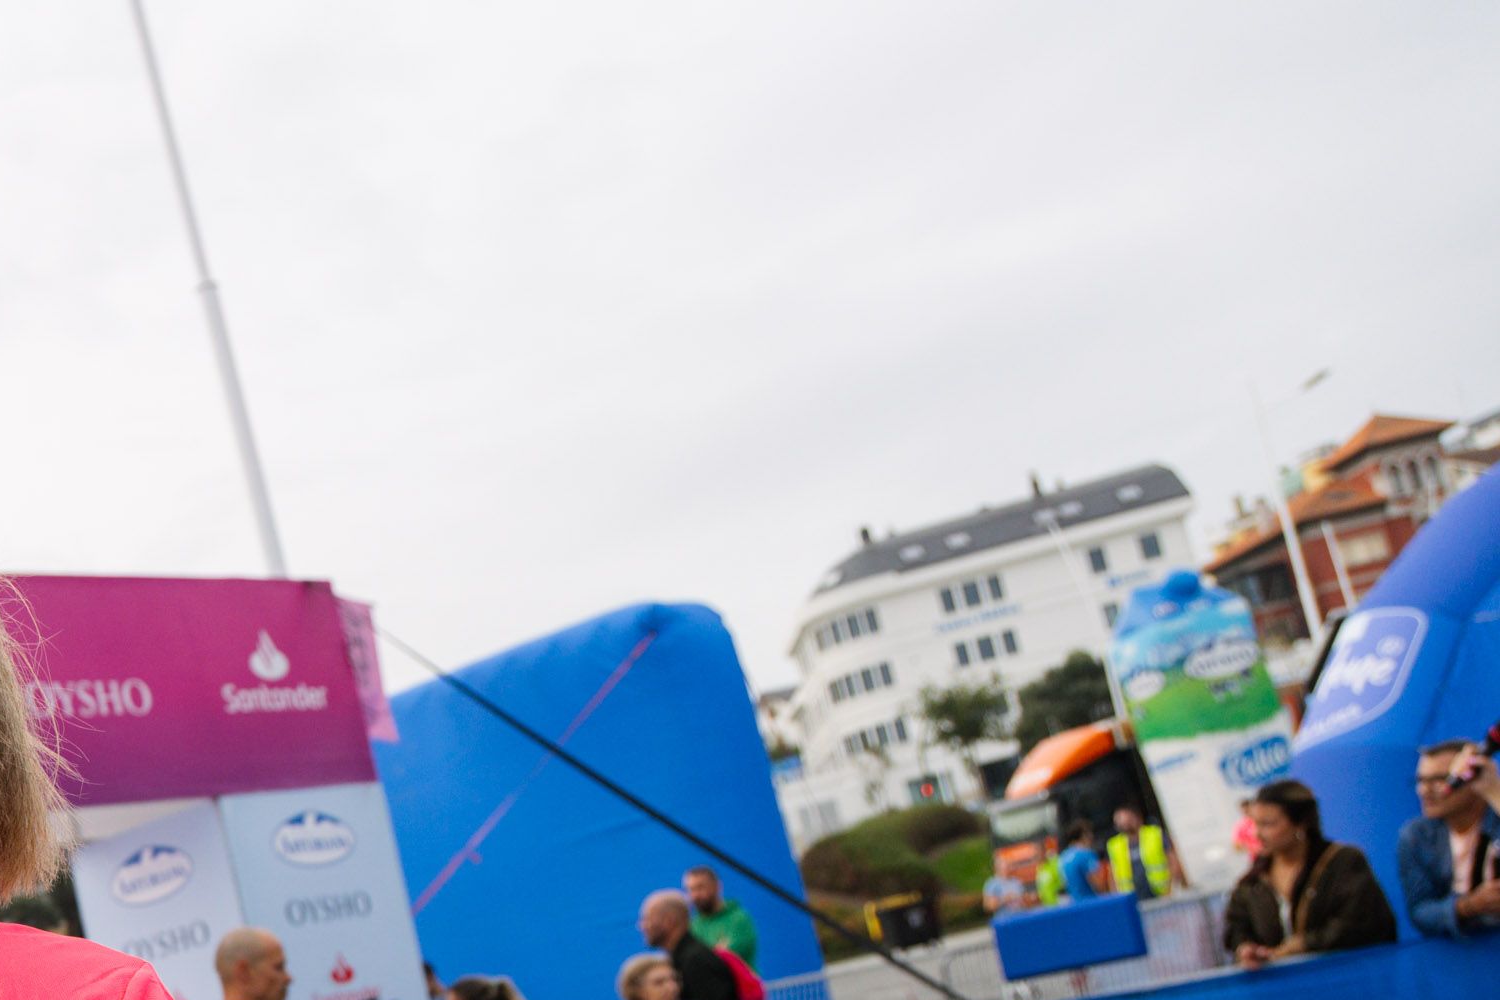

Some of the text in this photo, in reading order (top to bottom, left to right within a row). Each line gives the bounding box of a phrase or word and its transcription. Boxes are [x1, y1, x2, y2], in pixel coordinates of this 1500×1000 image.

[26, 677, 153, 718] OYSHO
[221, 682, 328, 715] Santander
[283, 891, 373, 926] OYSHO
[122, 920, 211, 959] OYSHO
